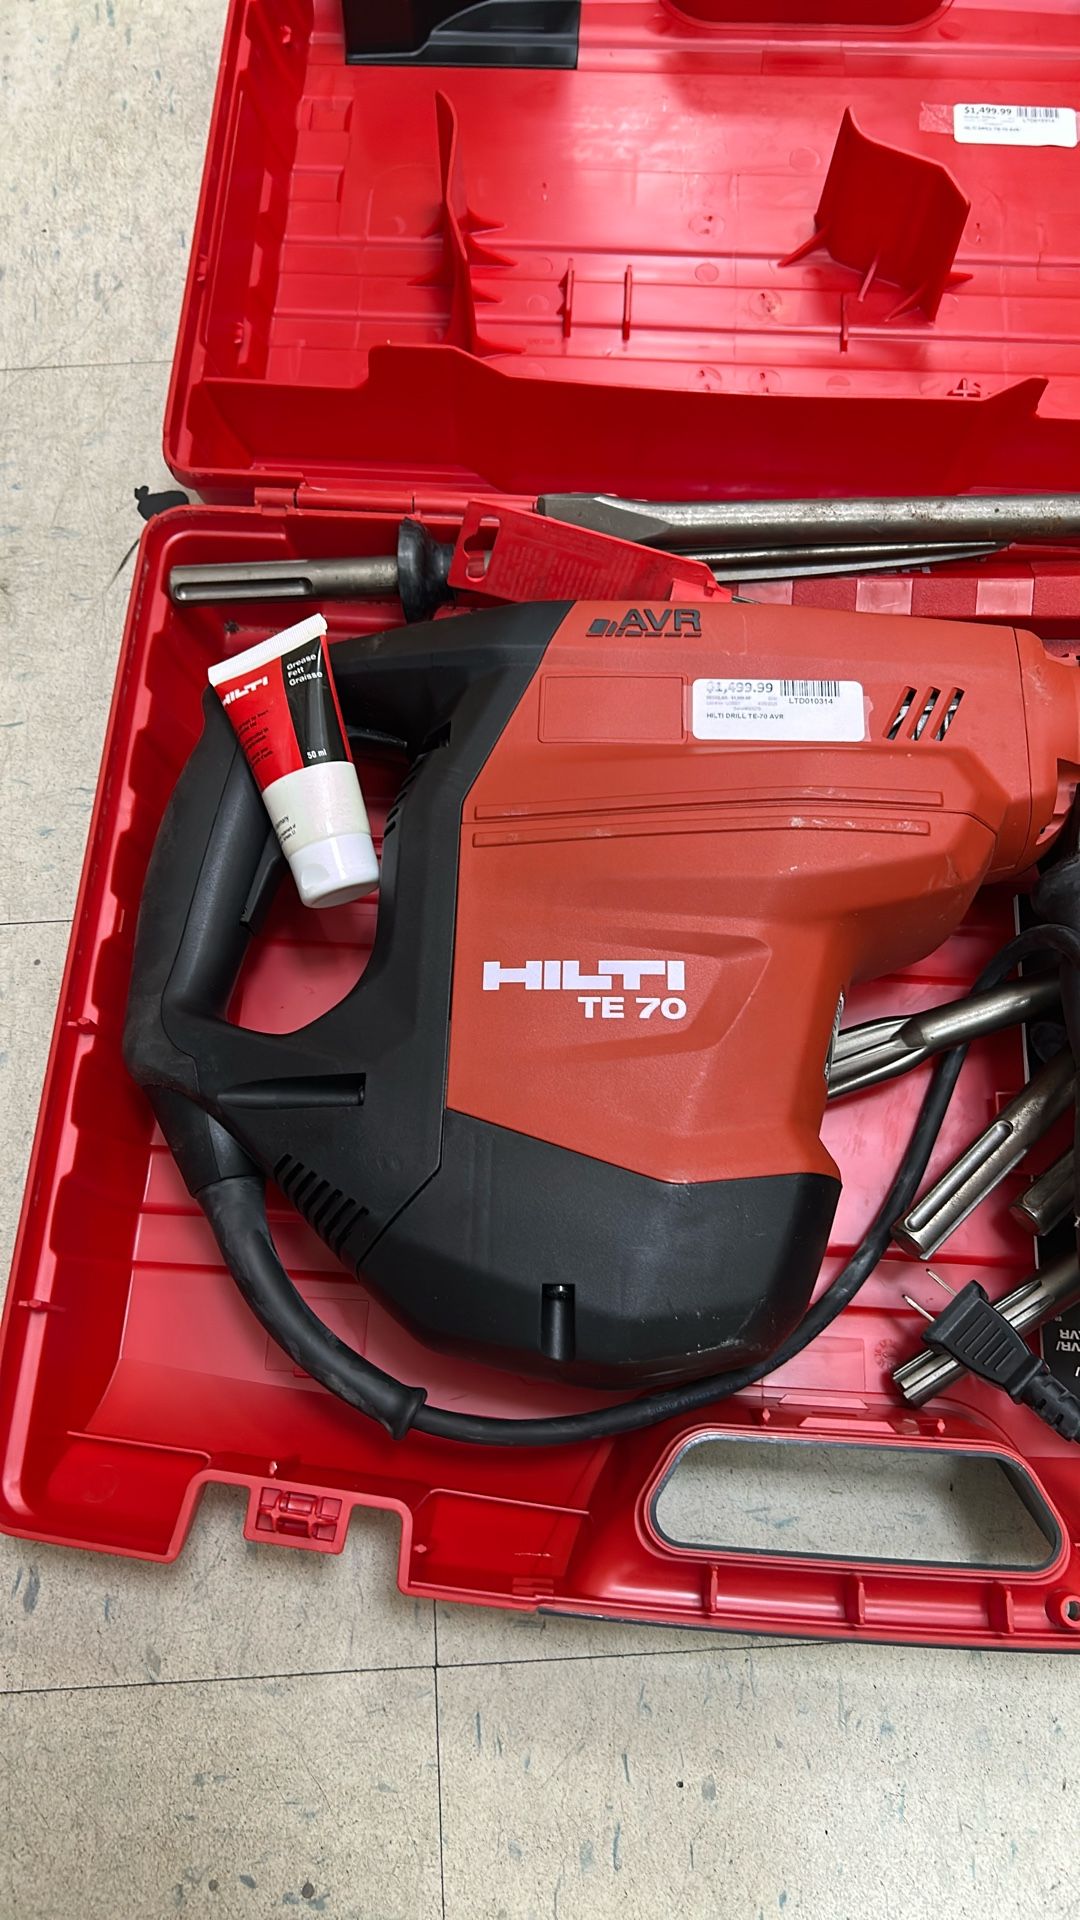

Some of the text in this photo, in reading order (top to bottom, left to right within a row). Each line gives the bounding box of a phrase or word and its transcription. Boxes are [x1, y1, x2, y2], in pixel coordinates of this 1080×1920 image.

[964, 106, 1012, 115] $1,499.99
[619, 608, 701, 632] AVR
[286, 653, 317, 671] Grease
[287, 666, 305, 679] Fett
[289, 671, 323, 687] Graisse
[788, 697, 834, 705] LTD010314
[706, 712, 724, 720] HILTI
[725, 712, 747, 720] DRILL
[769, 713, 785, 721] AVR
[307, 747, 328, 760] 50 ml
[482, 960, 686, 991] HILTI
[577, 996, 688, 1020] TE 70
[1059, 1329, 1080, 1340] VR
